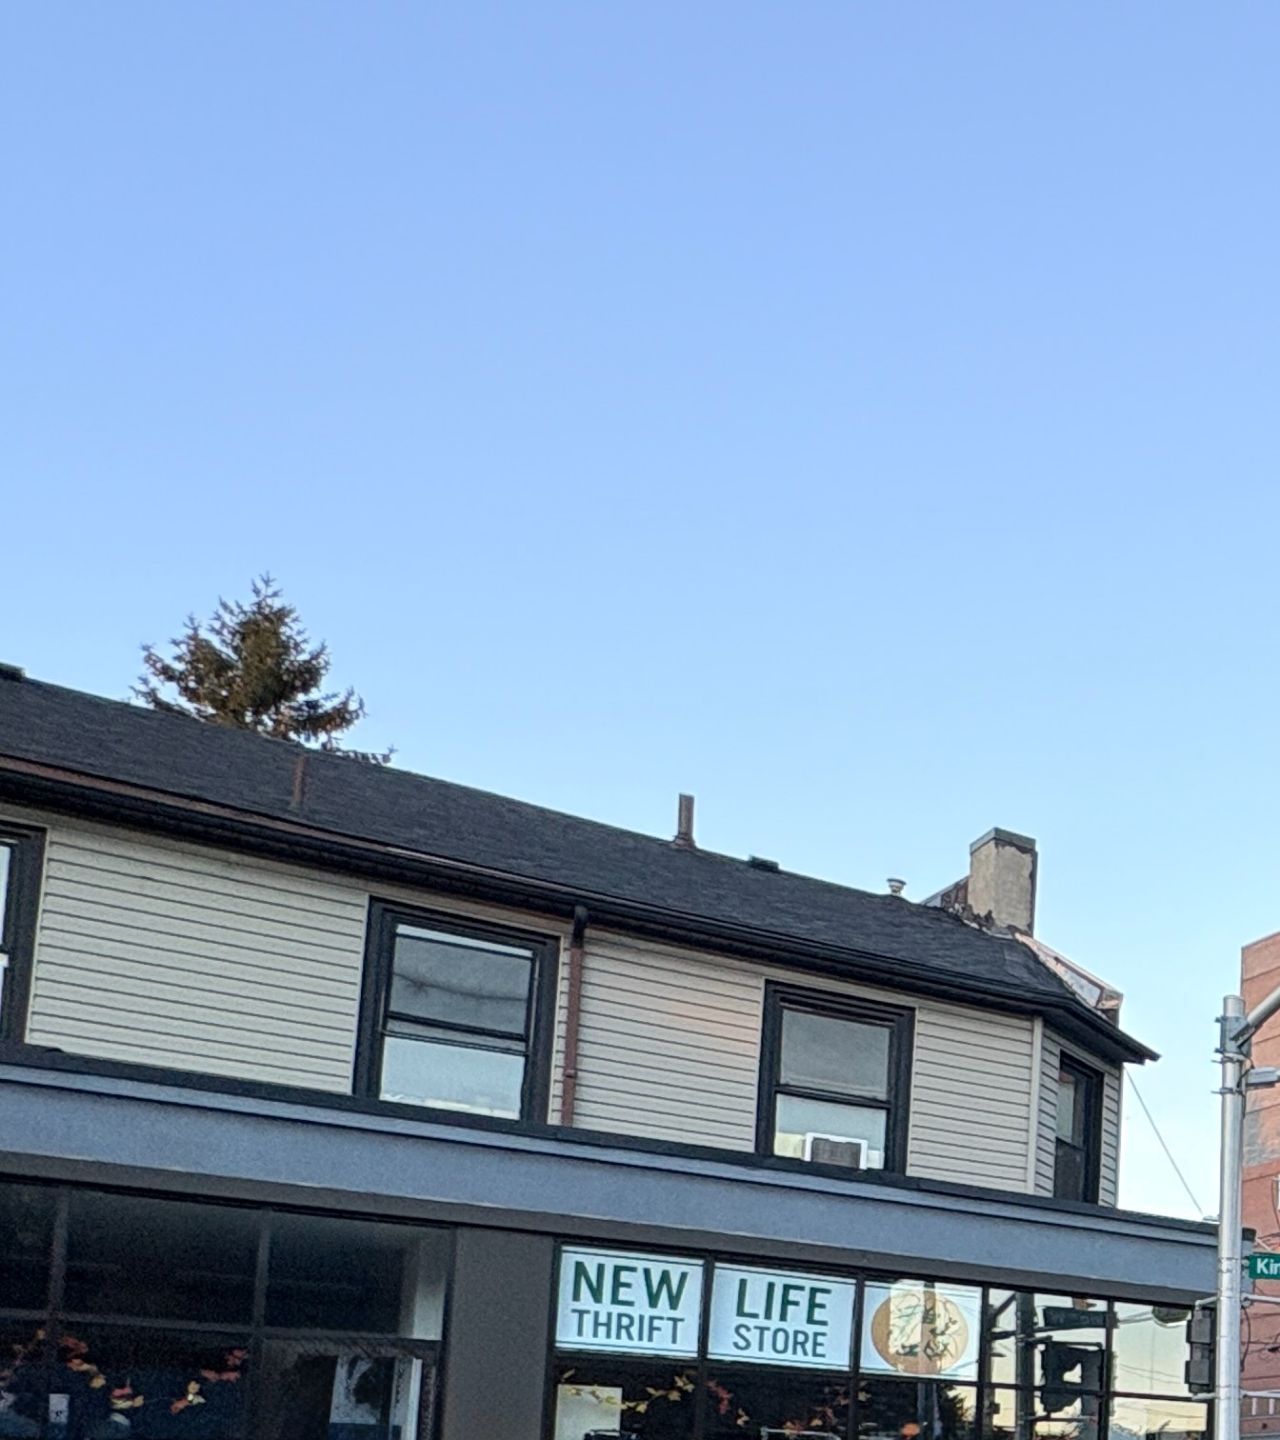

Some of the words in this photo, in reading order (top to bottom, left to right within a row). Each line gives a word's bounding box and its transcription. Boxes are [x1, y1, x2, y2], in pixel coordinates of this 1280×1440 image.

[571, 1260, 690, 1311] NEW
[735, 1278, 832, 1326] LIFE
[570, 1308, 685, 1345] THRIFT
[732, 1324, 828, 1358] STORE
